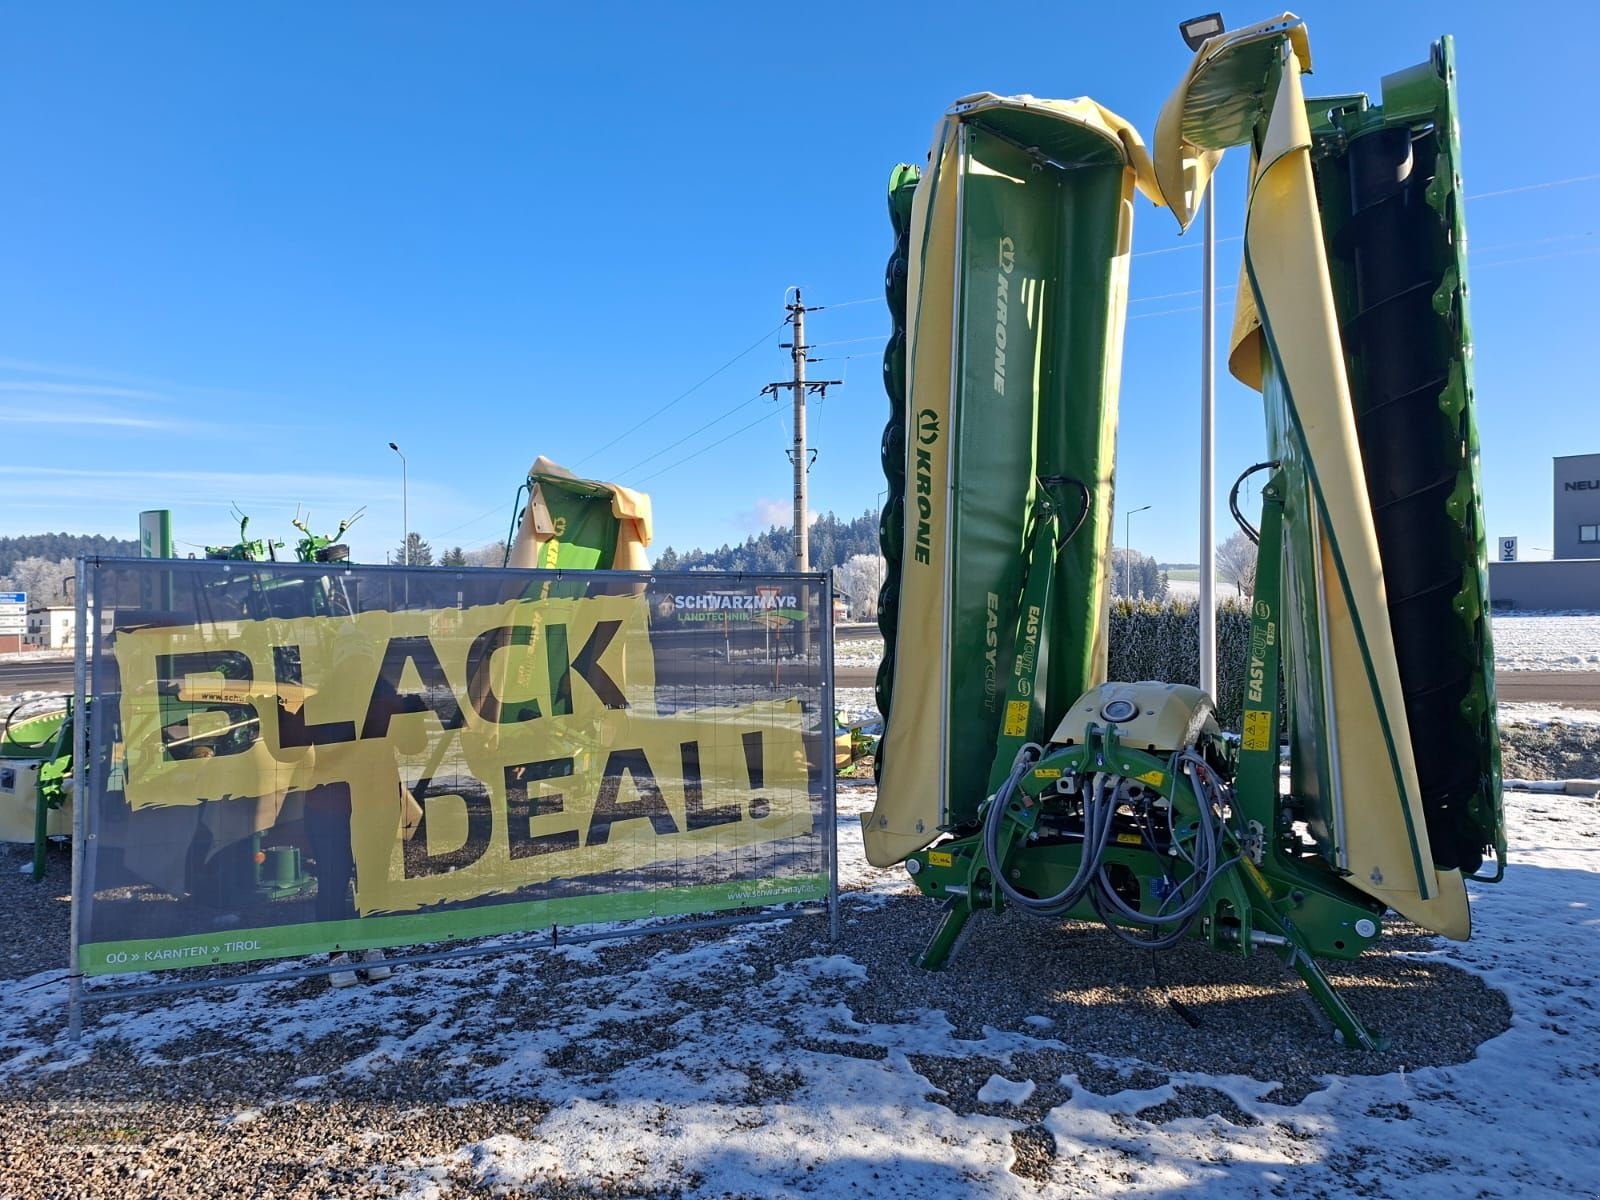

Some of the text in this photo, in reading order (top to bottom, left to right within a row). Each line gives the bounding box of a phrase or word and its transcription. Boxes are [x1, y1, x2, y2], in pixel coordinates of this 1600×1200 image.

[993, 273, 1009, 397] KRONE
[914, 447, 932, 566] KRONE
[674, 595, 798, 609] SCHWARZMAYR
[677, 612, 750, 622] LANDTECHNIK
[1022, 605, 1040, 673] EASYCUT
[155, 619, 630, 764] BLACK
[984, 591, 999, 713] EASYCUT
[1248, 626, 1267, 702] EASYCUT
[404, 731, 771, 880] DEAL!
[106, 951, 127, 964] OÖ
[144, 945, 208, 961] KÄRNTEN
[224, 940, 261, 953] TIROL
